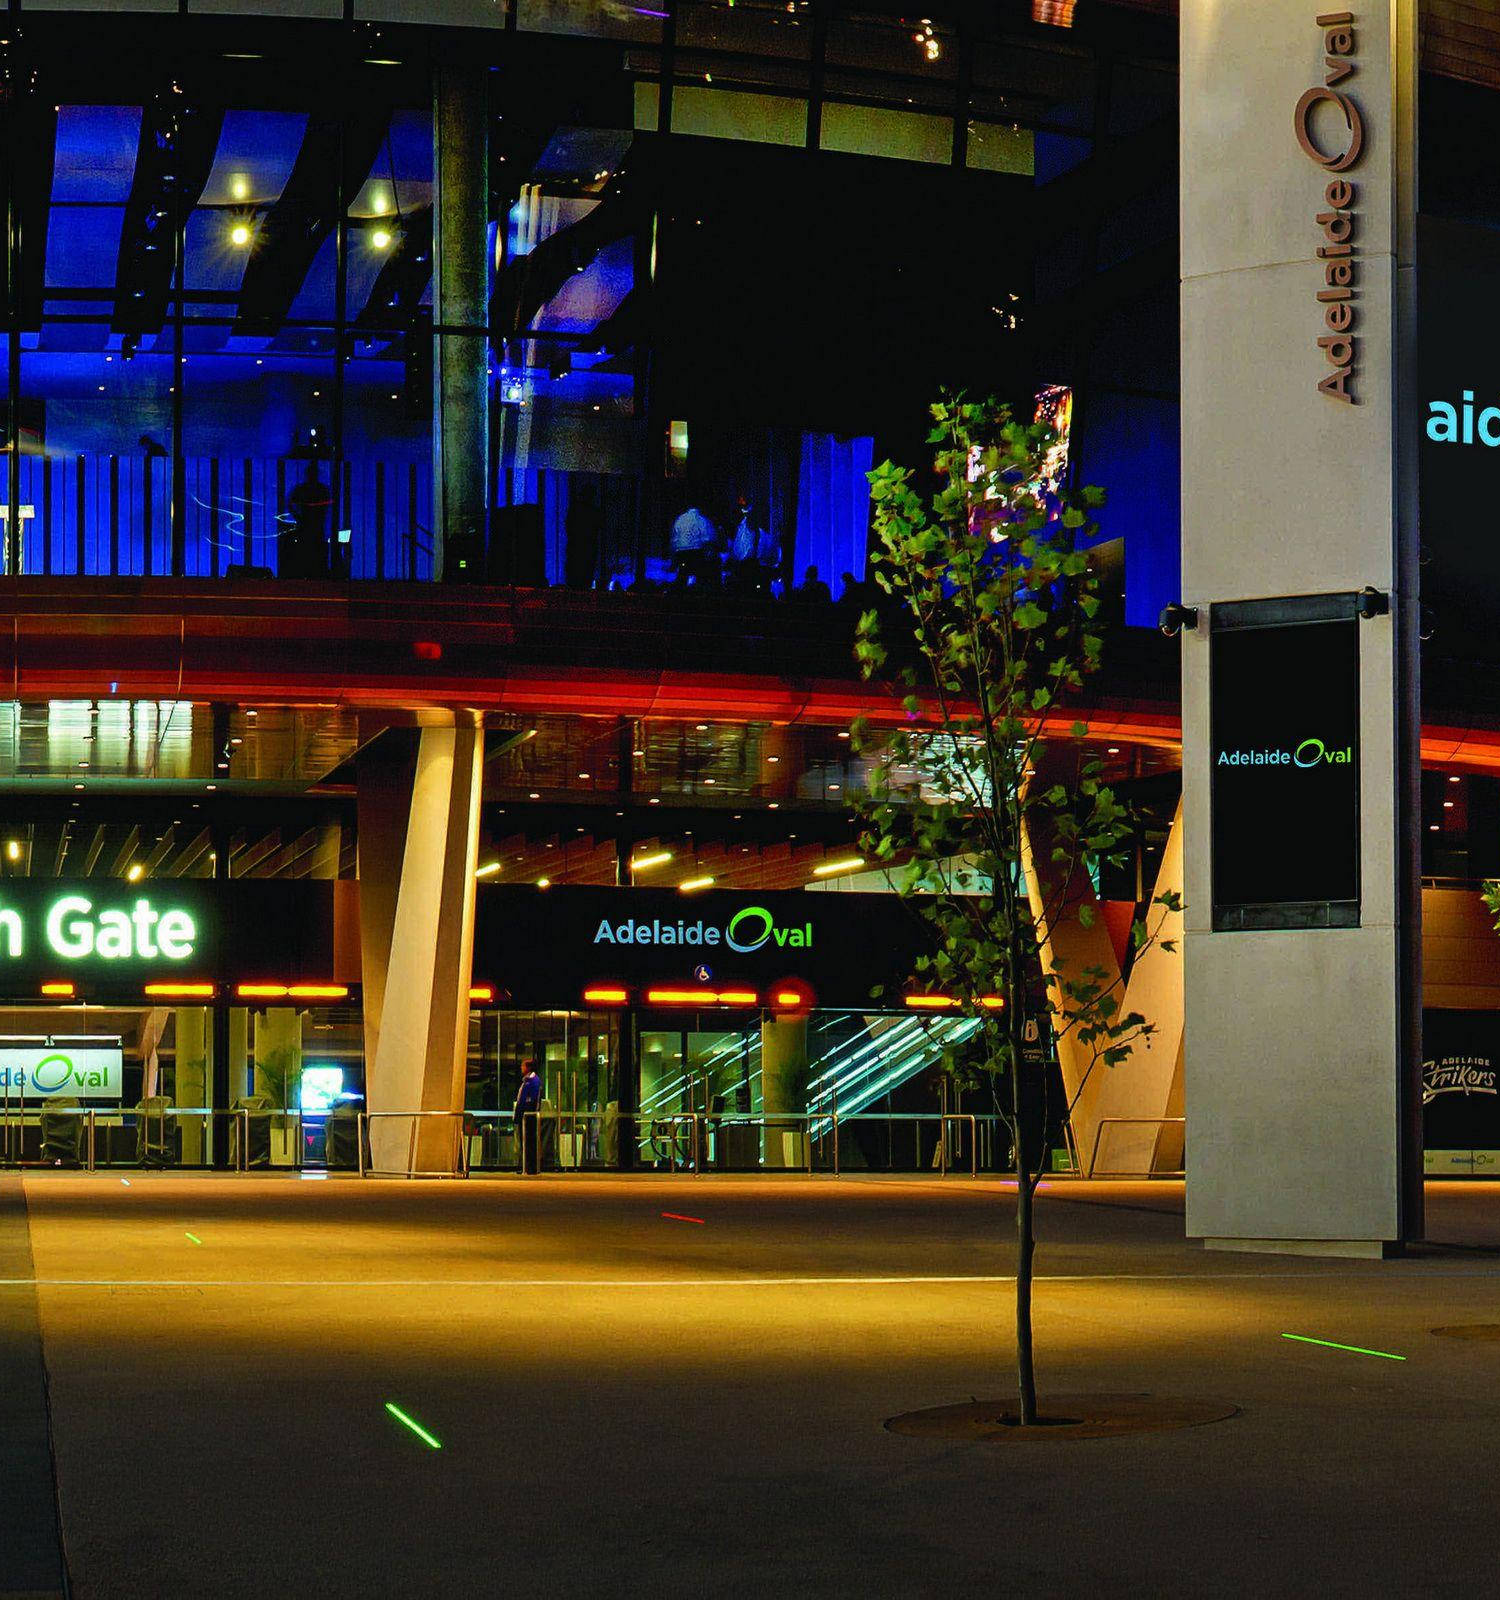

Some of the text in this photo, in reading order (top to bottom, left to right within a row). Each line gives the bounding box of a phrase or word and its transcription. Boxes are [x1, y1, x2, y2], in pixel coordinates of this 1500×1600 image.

[1295, 12, 1362, 405] Adelaide Oval
[1218, 738, 1352, 768] Adelaide Oval
[45, 895, 197, 960] Gate
[593, 906, 813, 953] Adelaide Oval
[31, 1053, 109, 1093] Oval
[1441, 1056, 1491, 1066] ADELAIDE
